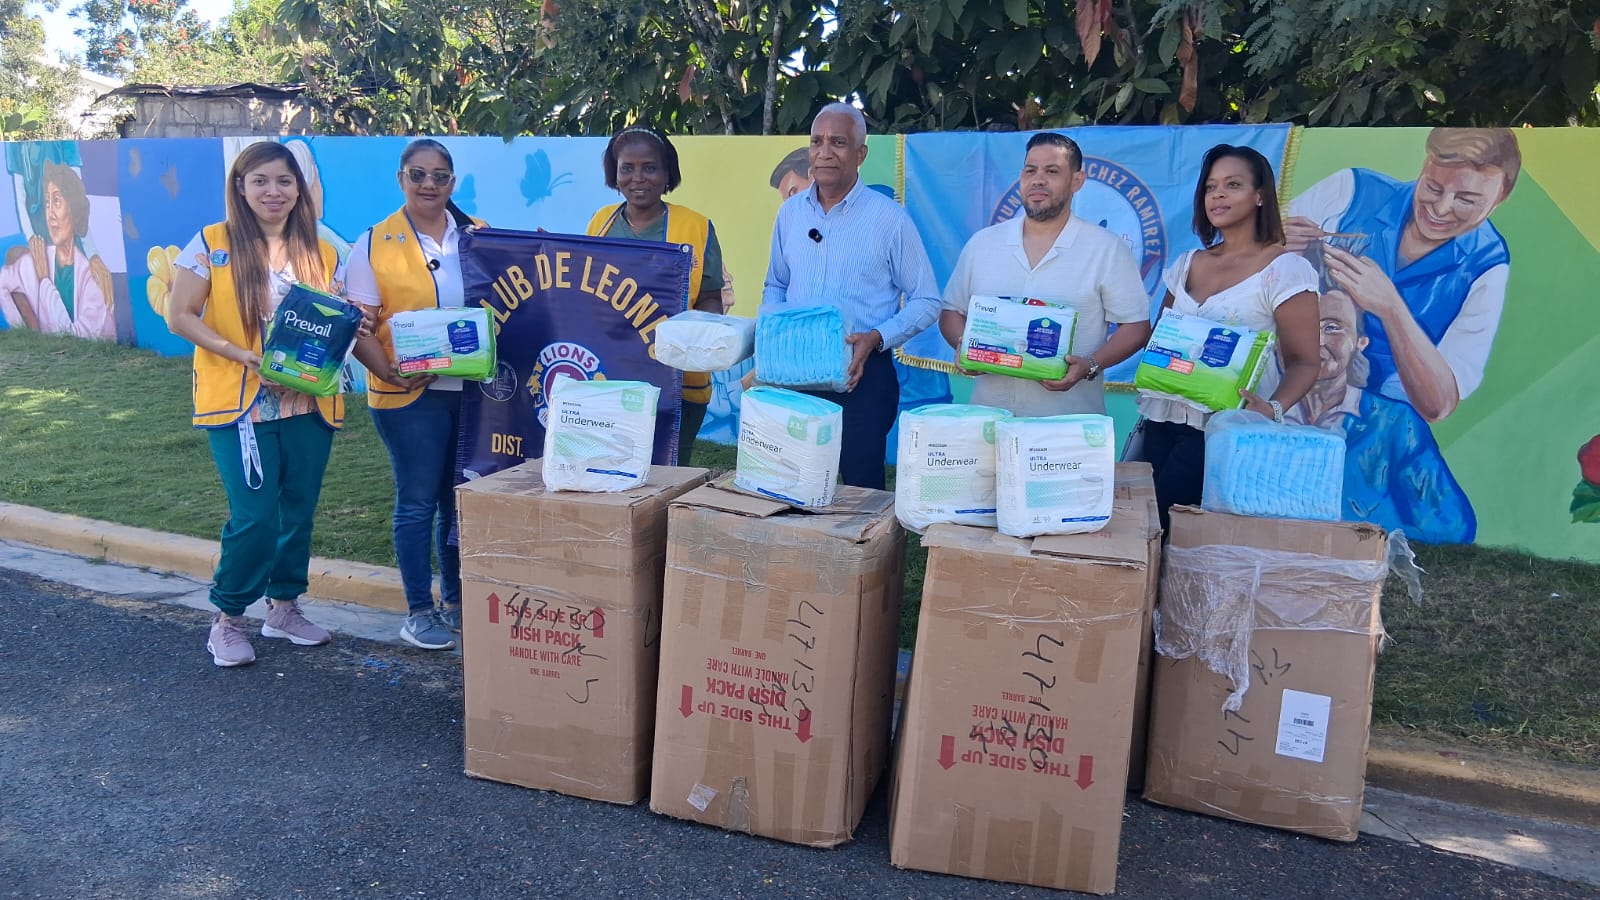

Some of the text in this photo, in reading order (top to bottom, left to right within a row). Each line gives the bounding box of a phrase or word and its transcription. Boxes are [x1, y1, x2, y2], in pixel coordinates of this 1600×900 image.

[480, 265, 534, 336] LUB
[534, 251, 572, 290] DE
[284, 310, 333, 338] Prevail
[542, 344, 598, 370] LIONS
[560, 415, 616, 428] Underwear
[490, 433, 525, 458] DIST.
[741, 433, 784, 454] Underwear
[927, 457, 979, 467] Underwear
[1029, 461, 1082, 471] Underwear
[504, 604, 588, 626] THIS SIDE UP
[511, 624, 581, 649] DISH PACK
[509, 645, 538, 661] HANDLE
[540, 651, 560, 664] WITH
[562, 653, 582, 667] CARE
[706, 658, 789, 685] HANDLE WITH CARE
[706, 677, 744, 700] PACK
[750, 686, 787, 708] DISH
[698, 701, 792, 731] THIS SIDE UP
[972, 704, 1068, 731] HANDLE WITH CARE
[971, 724, 1017, 747] PACK
[1023, 732, 1065, 754] DISH
[1218, 707, 1254, 755] 47
[961, 749, 1071, 778] THIS SIDE UP
